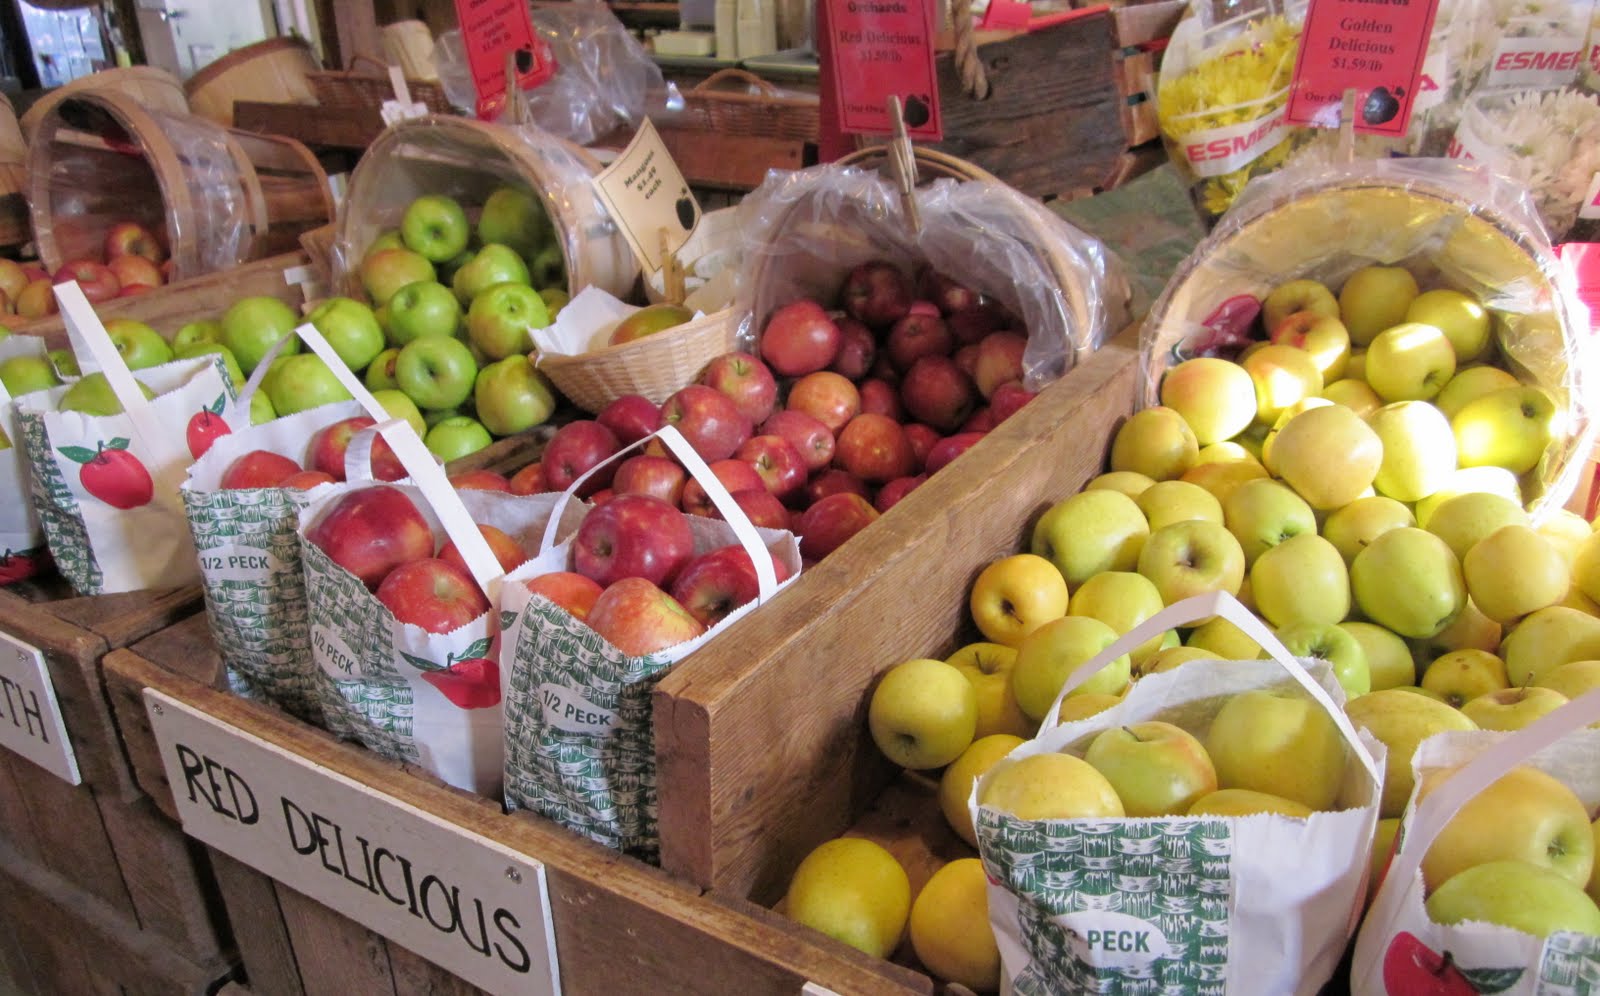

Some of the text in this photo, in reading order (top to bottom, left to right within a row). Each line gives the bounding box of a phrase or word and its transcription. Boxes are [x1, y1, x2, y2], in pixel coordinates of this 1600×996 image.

[1340, 16, 1393, 34] Golden
[1328, 36, 1395, 56] Delicious
[1332, 56, 1383, 72] $1.59/lb
[201, 556, 270, 570] 1/2 PECK
[313, 631, 354, 676] 1/2 PECK
[0, 674, 50, 745] TH
[543, 689, 612, 726] 1/2 PECK
[175, 743, 532, 974] RED DELICIOUS
[1087, 930, 1151, 953] PECK
